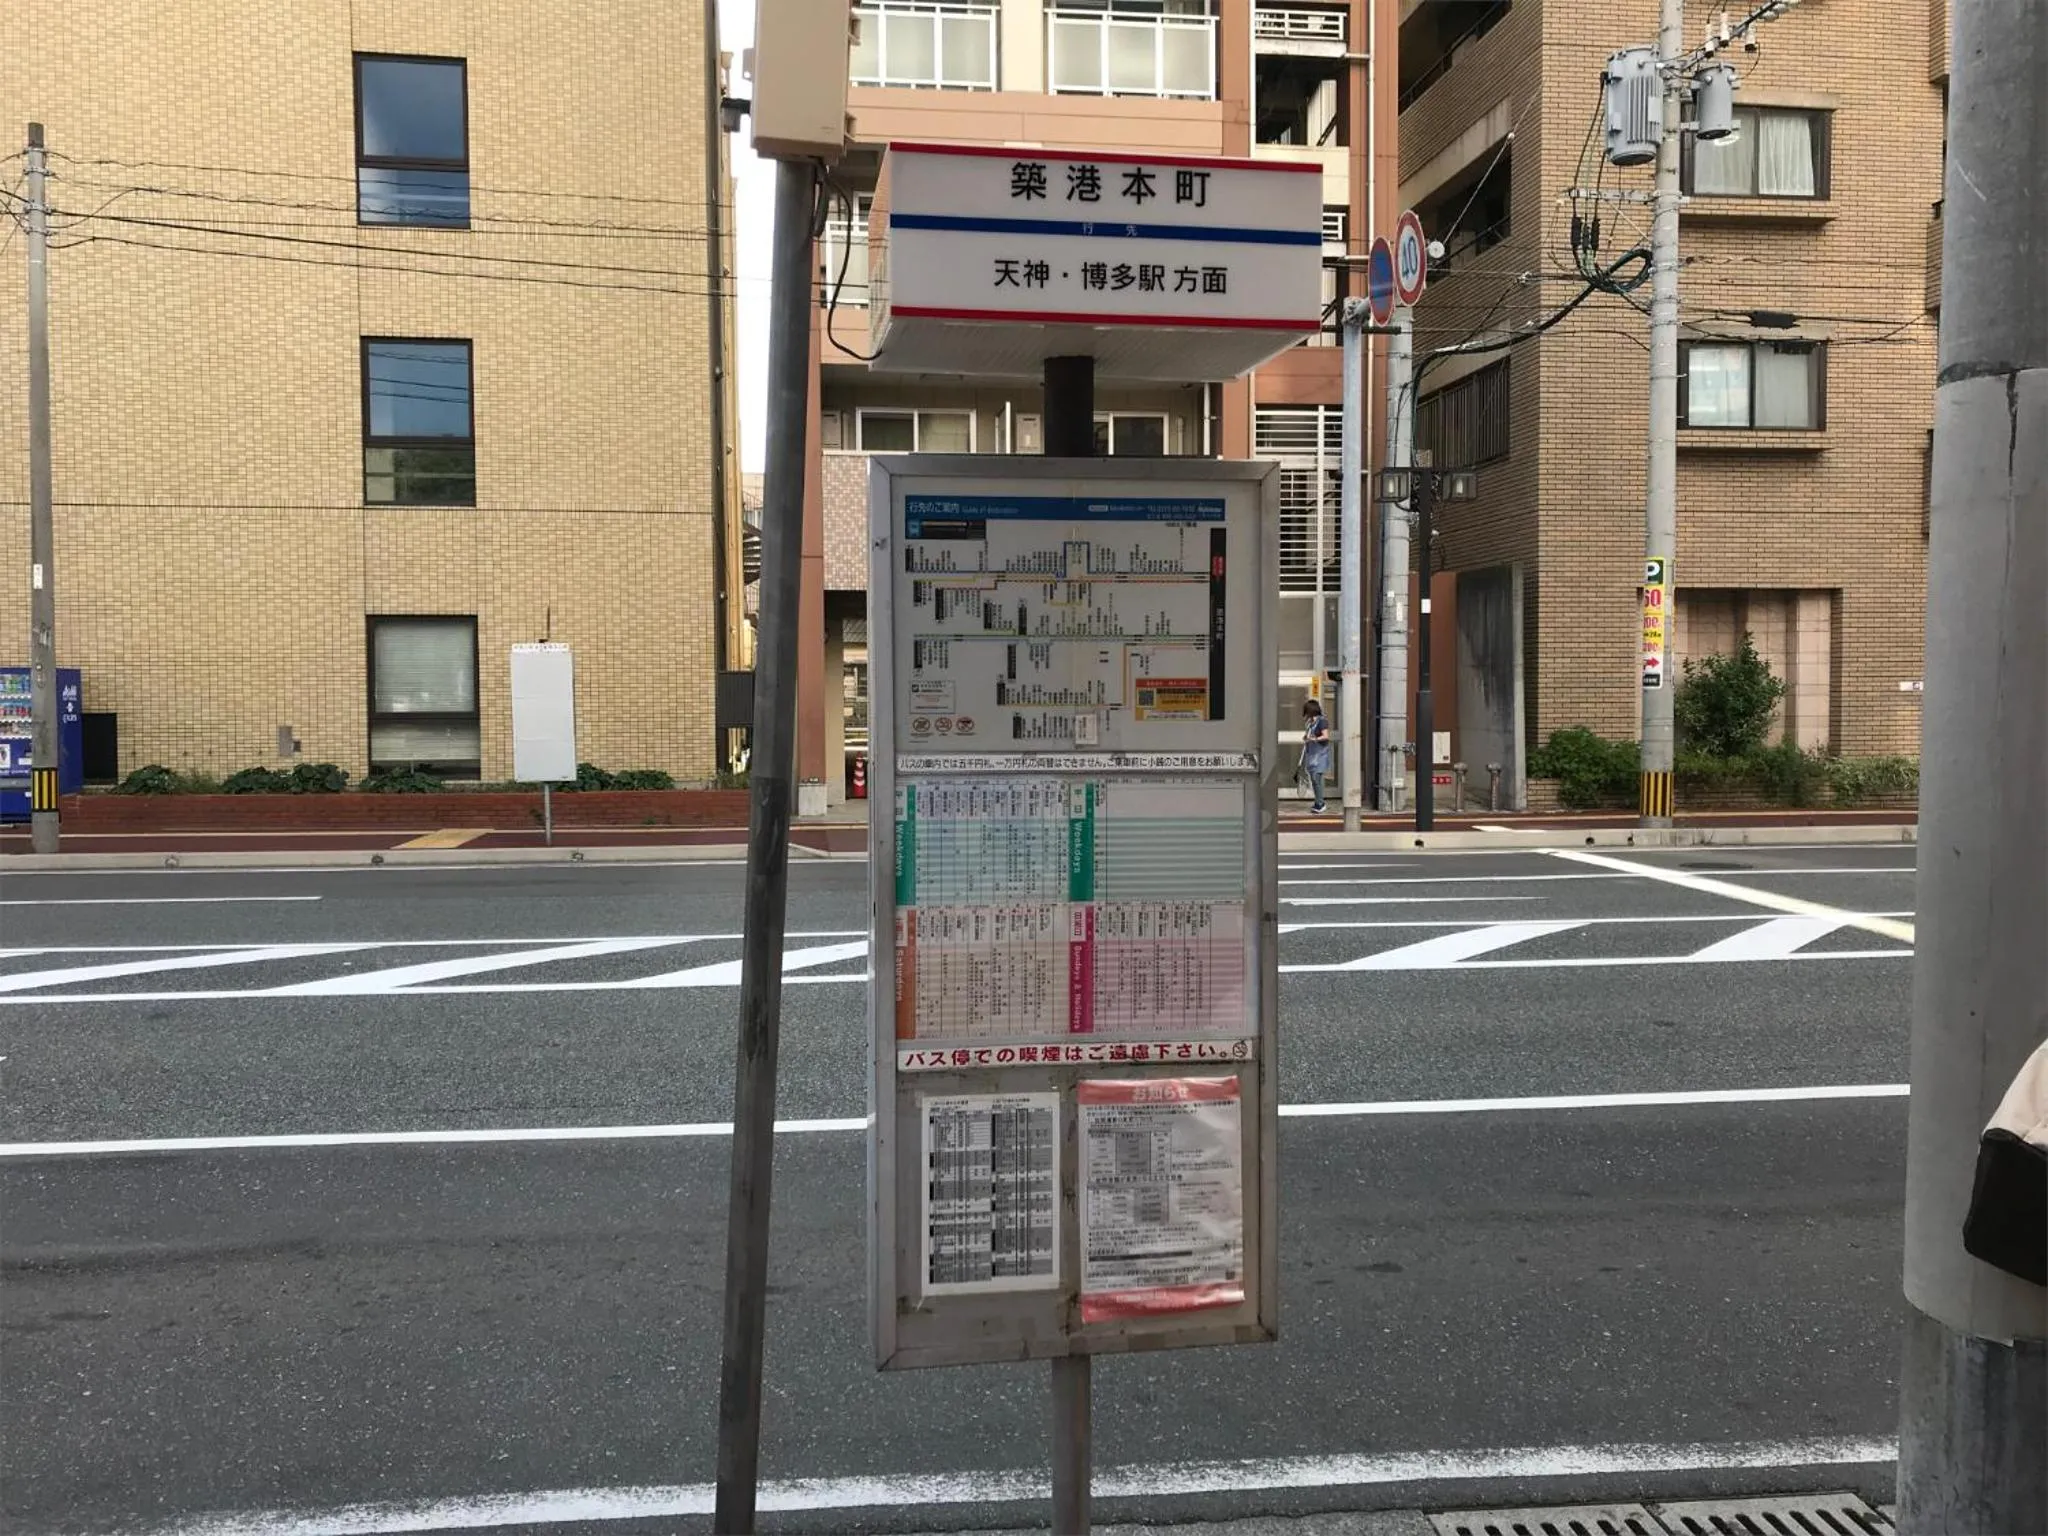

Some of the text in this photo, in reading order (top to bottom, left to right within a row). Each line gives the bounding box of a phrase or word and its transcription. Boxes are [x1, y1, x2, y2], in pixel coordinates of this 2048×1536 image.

[1010, 161, 1211, 208] 築港本町
[1645, 561, 1660, 584] P
[1072, 821, 1083, 873] Weekdays
[904, 1043, 1228, 1067] バス停での喫煙はご遠慮下さい。
